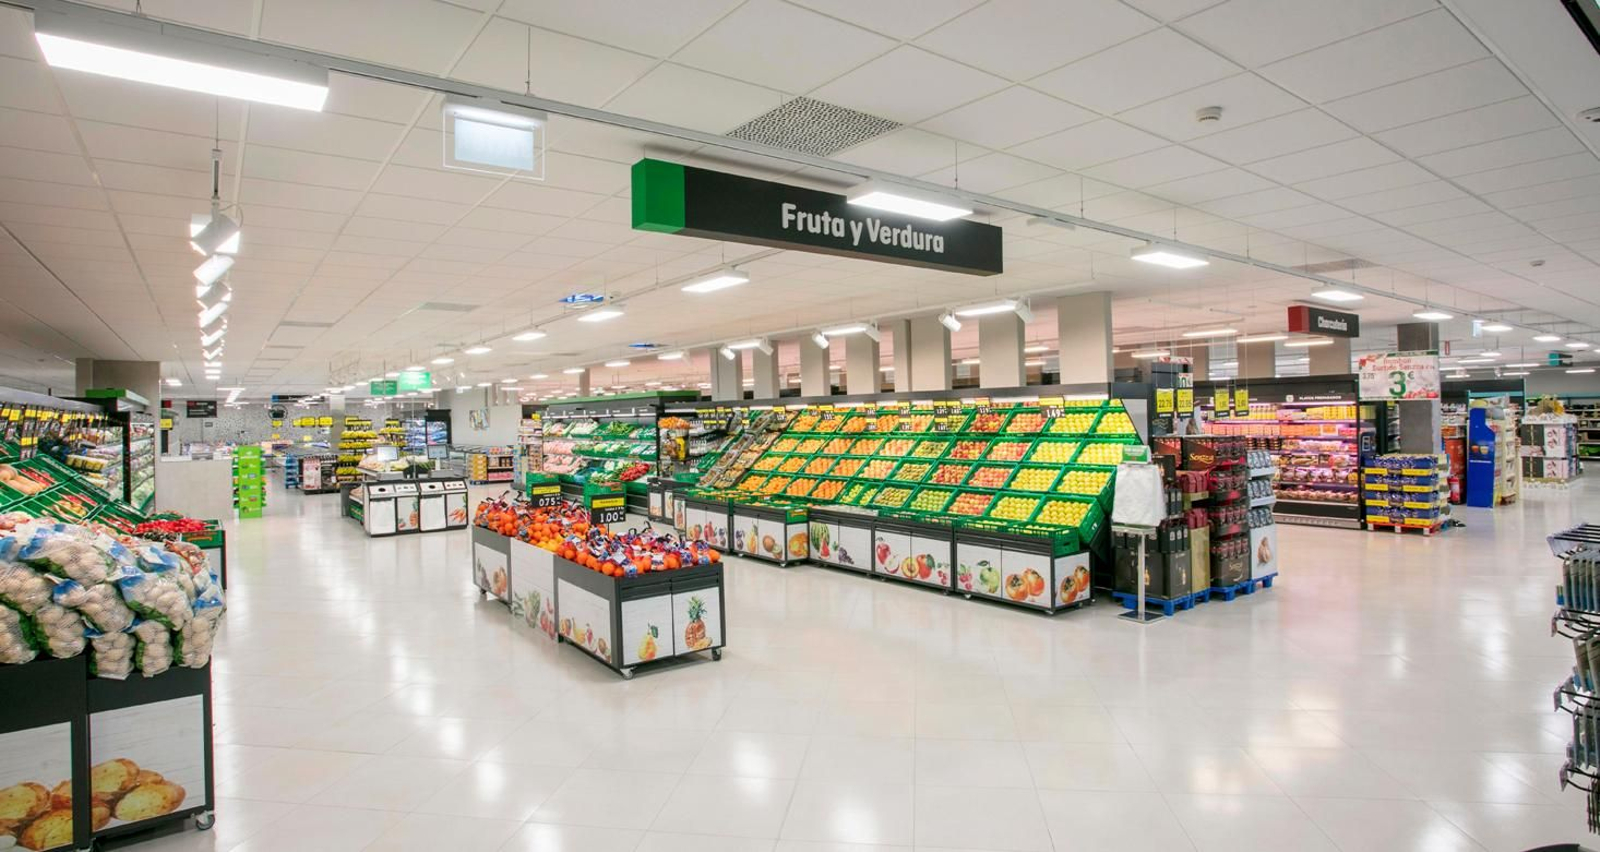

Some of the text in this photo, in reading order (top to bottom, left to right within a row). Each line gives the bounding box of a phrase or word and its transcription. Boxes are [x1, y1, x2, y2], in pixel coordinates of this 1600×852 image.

[781, 202, 945, 254] Fruta y Verdura
